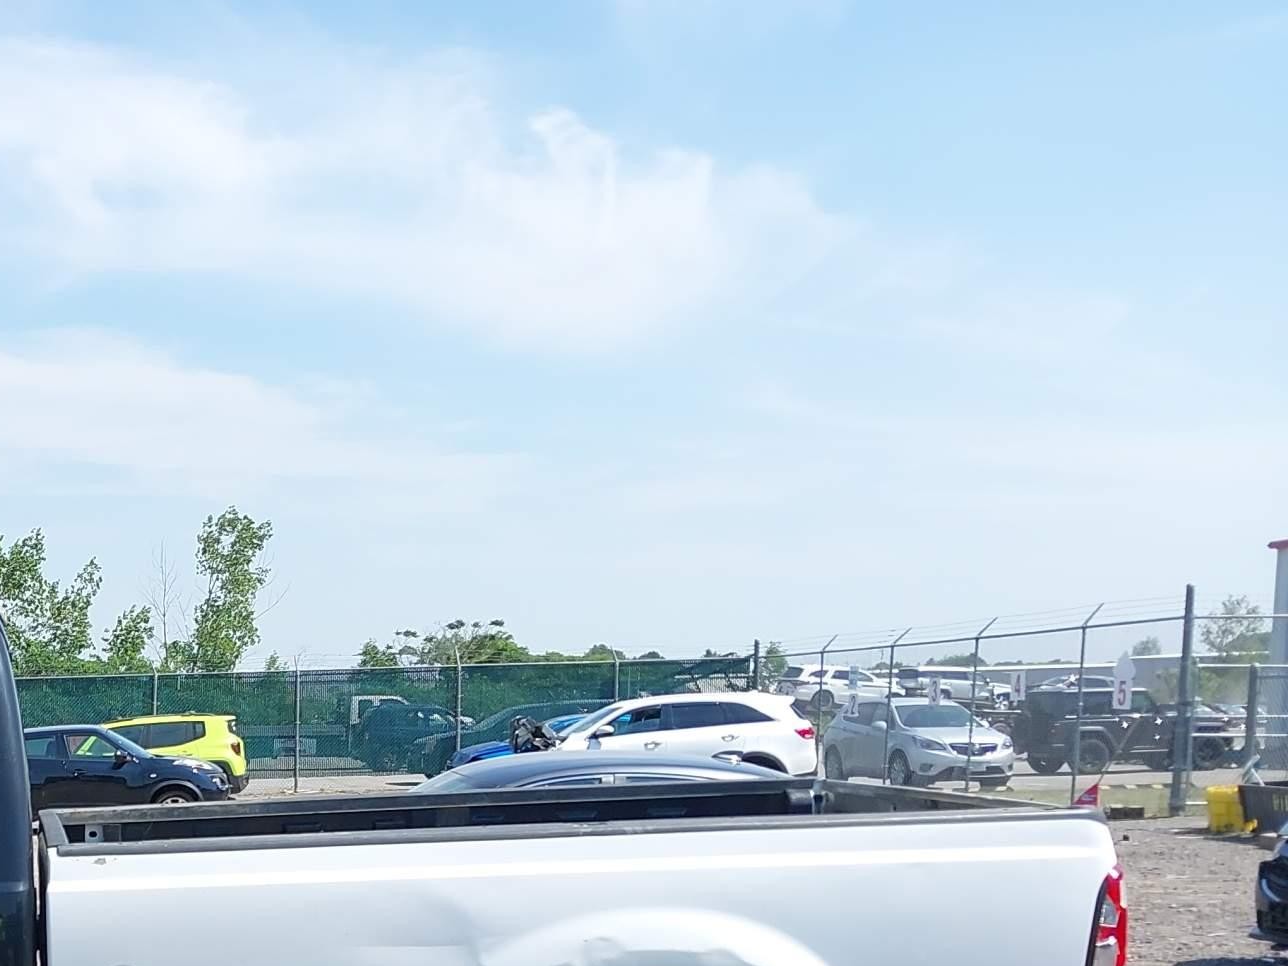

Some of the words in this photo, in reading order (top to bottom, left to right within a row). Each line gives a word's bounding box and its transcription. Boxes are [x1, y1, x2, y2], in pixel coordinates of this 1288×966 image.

[930, 680, 939, 702] 3
[1013, 673, 1022, 697] 4
[1116, 680, 1127, 706] 5
